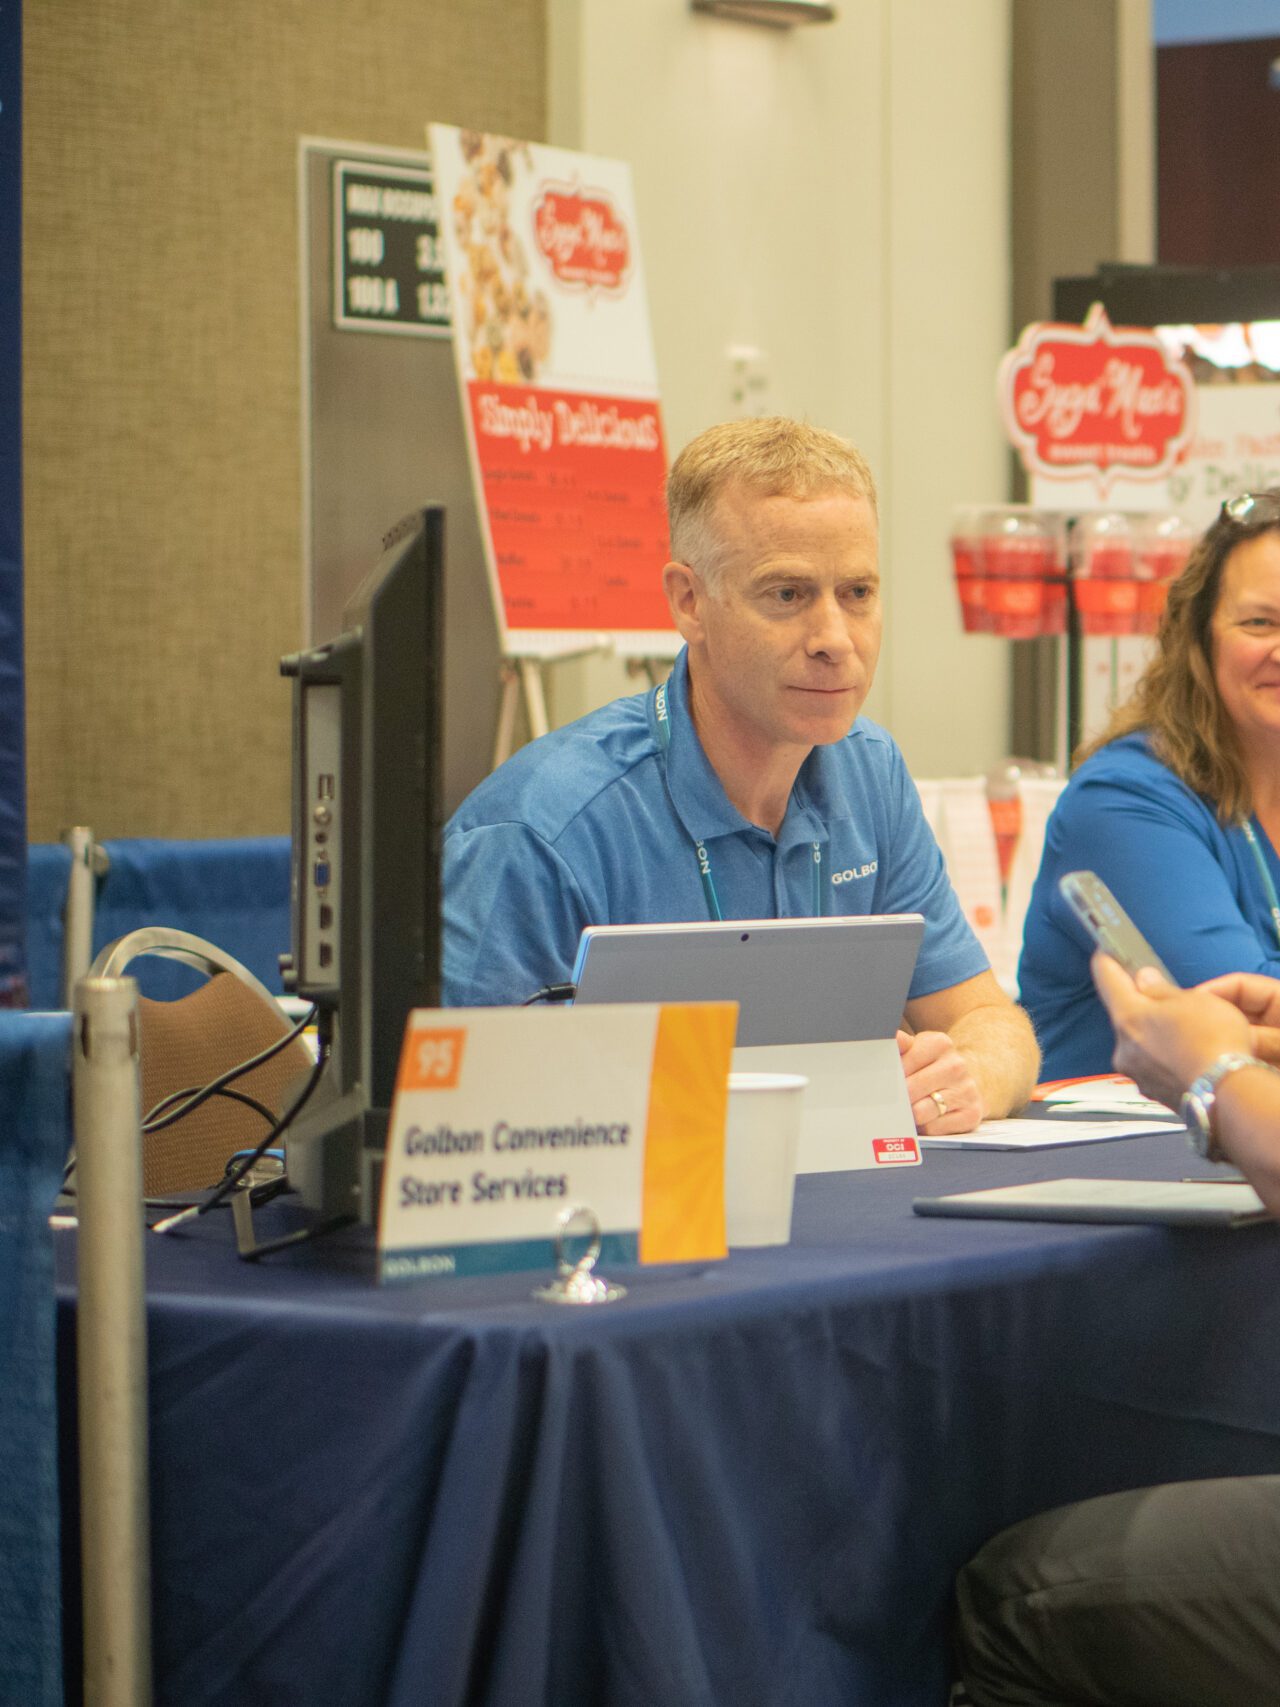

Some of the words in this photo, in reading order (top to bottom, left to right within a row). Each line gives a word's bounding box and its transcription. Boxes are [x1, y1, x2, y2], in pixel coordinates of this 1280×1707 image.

[479, 394, 554, 455] Simply
[554, 400, 660, 452] Delicious
[418, 1038, 456, 1079] 95
[405, 1123, 484, 1157] Golbon
[493, 1116, 631, 1151] Convenience
[399, 1174, 461, 1208] Store
[472, 1167, 567, 1203] Services
